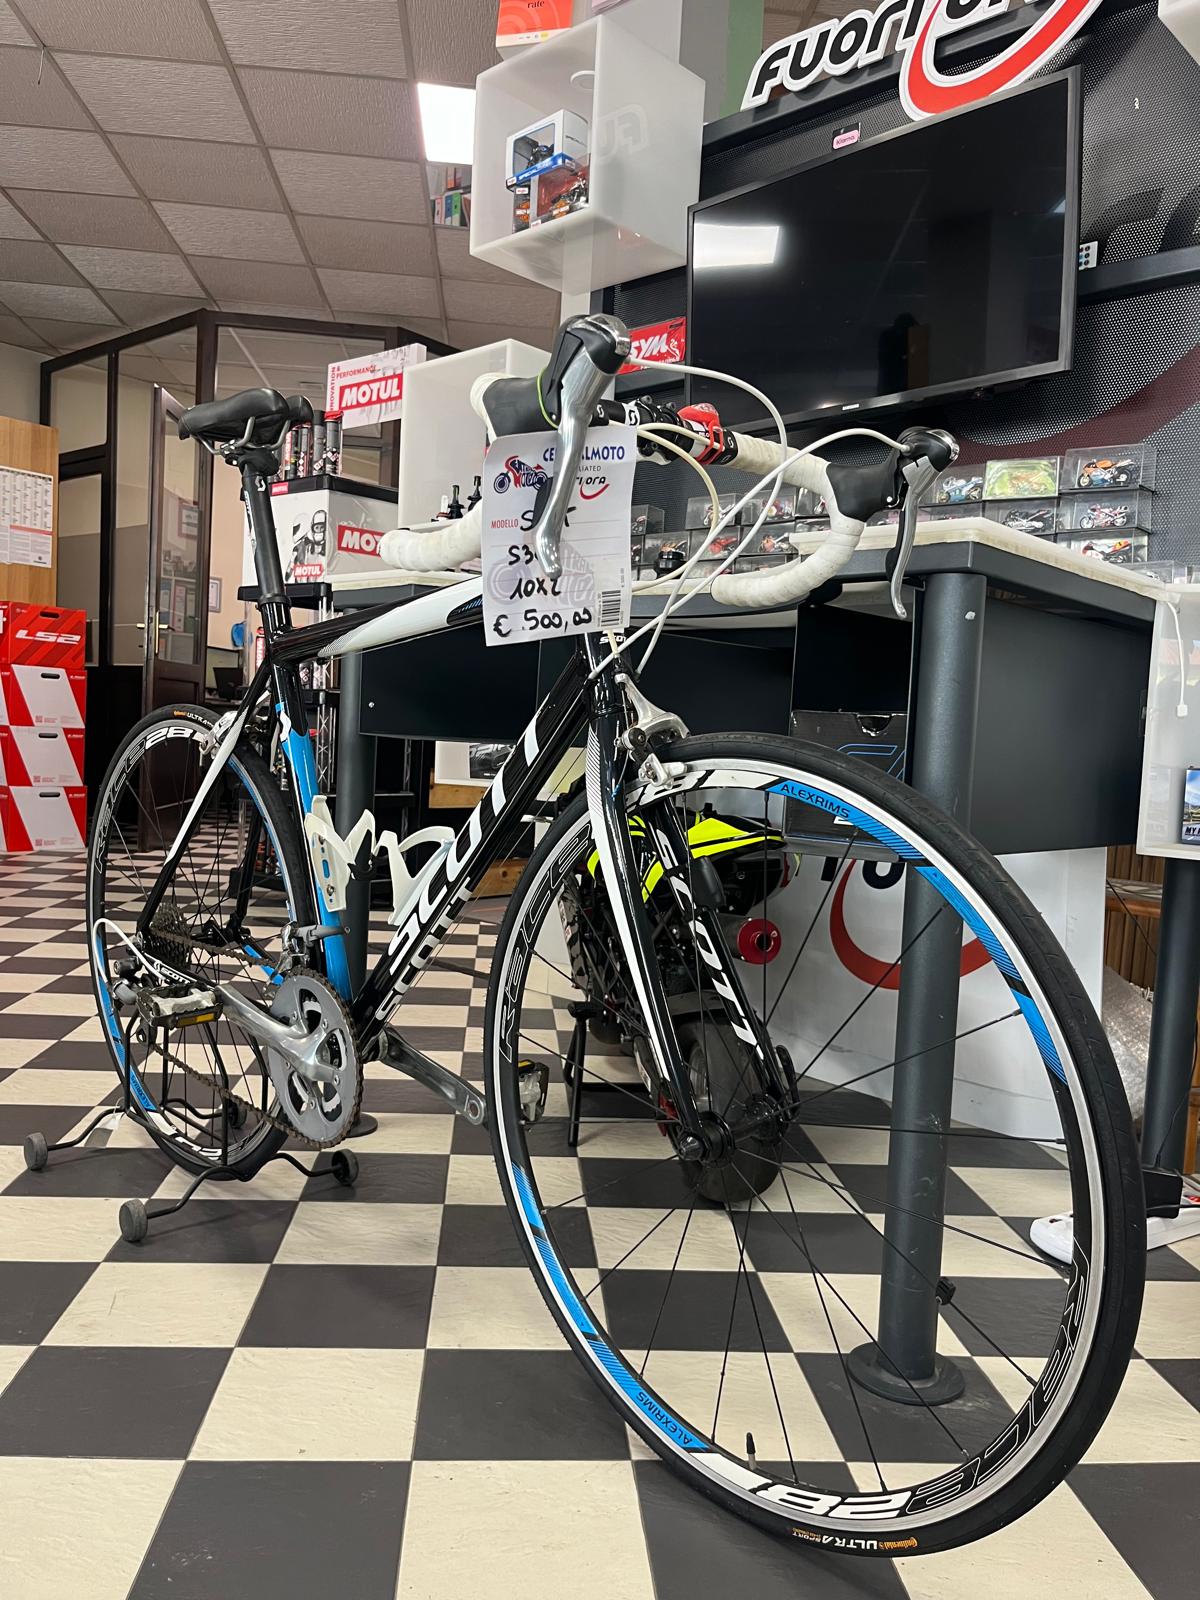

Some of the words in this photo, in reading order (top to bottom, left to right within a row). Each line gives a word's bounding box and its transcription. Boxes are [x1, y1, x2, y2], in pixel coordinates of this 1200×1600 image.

[630, 333, 668, 360] SYM
[341, 378, 400, 408] MOTUL
[491, 519, 519, 529] MODELLO
[294, 565, 321, 576] MOTUL
[16, 629, 81, 645] LS2
[493, 614, 512, 637] €
[145, 726, 194, 751] 28
[781, 783, 850, 819] ALEXRIMS
[388, 706, 548, 976] SCOTT
[374, 875, 474, 1021] SCOTT
[656, 828, 765, 1062] SCOTT
[160, 966, 191, 985] SCOTT
[636, 1391, 693, 1446] ALEXRIMS
[756, 1484, 912, 1520] 28
[822, 1535, 878, 1550] ULTRA
